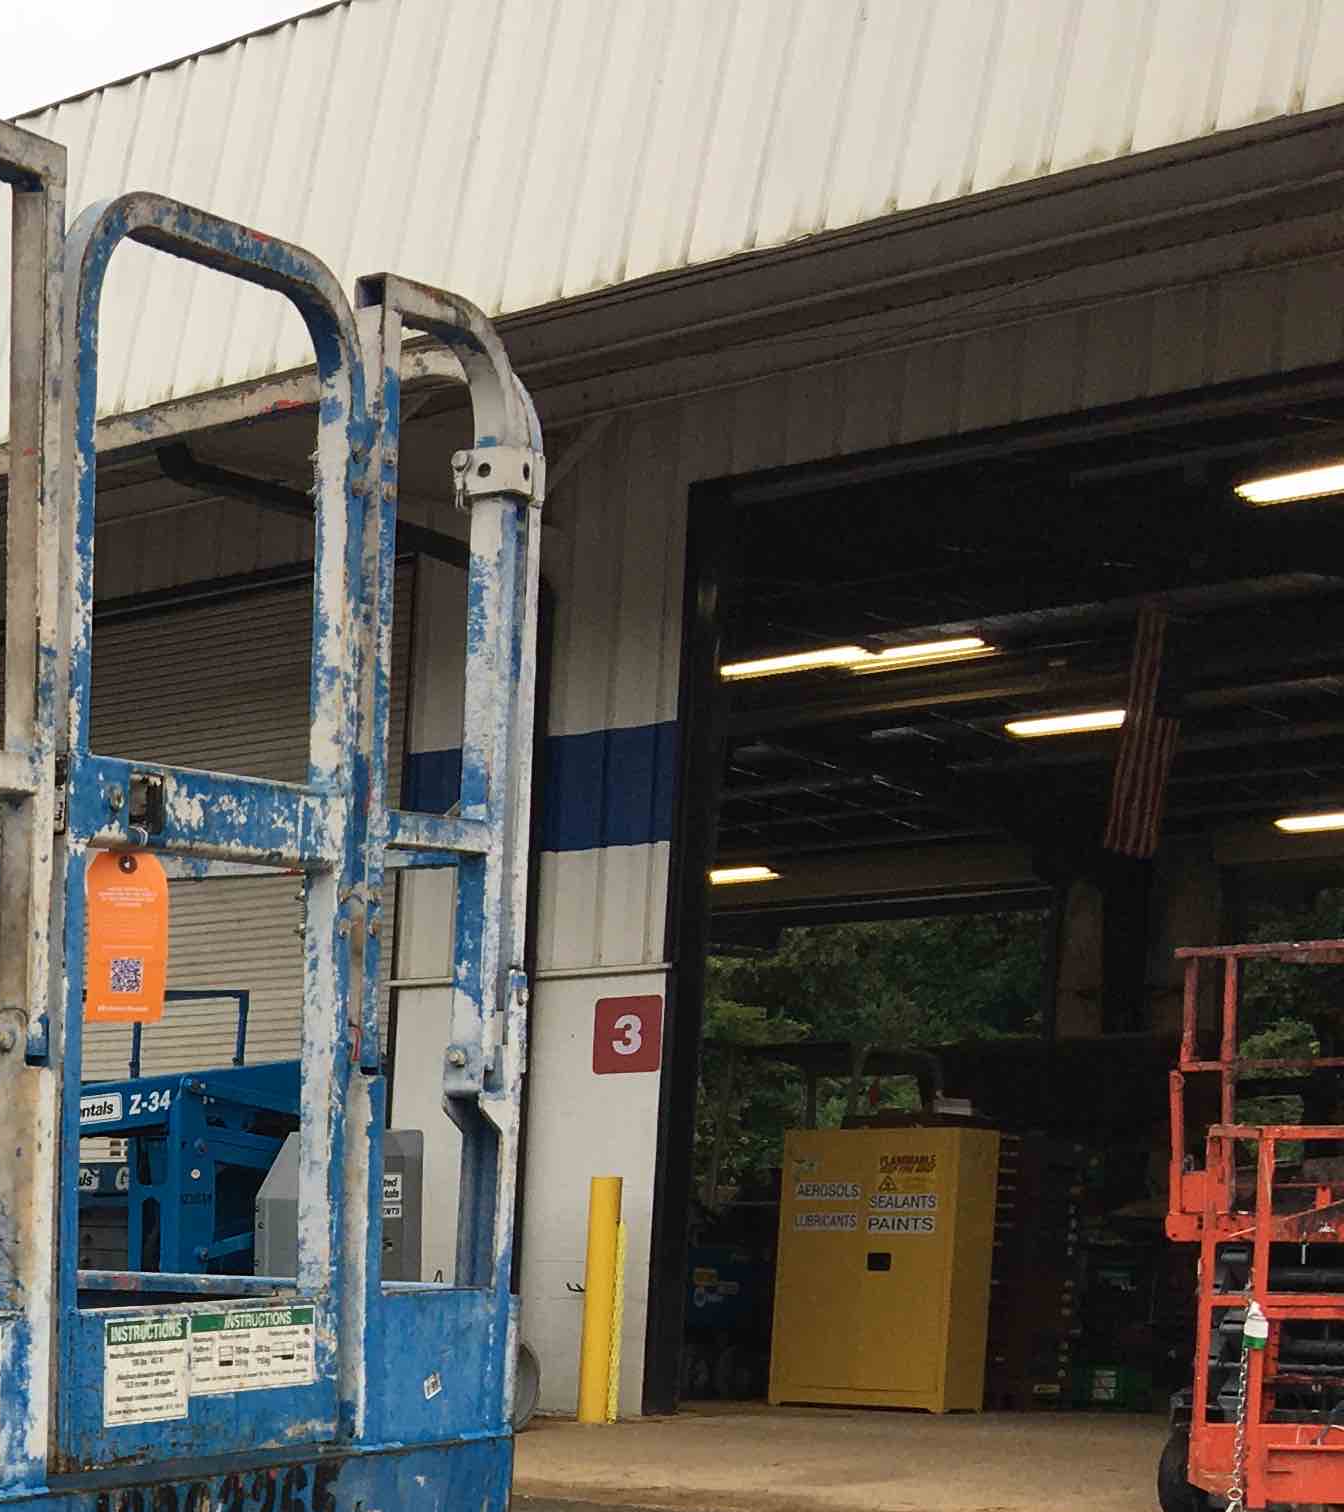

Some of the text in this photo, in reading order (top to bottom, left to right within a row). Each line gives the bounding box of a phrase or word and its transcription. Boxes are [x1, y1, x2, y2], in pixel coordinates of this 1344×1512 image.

[612, 1014, 642, 1055] 3
[128, 1090, 172, 1116] Z-34
[797, 1183, 859, 1198] AEROSOLS
[870, 1194, 937, 1209] SEALANTS
[795, 1213, 857, 1228] LUBRICANTS
[867, 1216, 934, 1231] PAINTS
[223, 1310, 294, 1330] INSTRUCTIONS
[110, 1319, 184, 1344] INSTRUCTIONS
